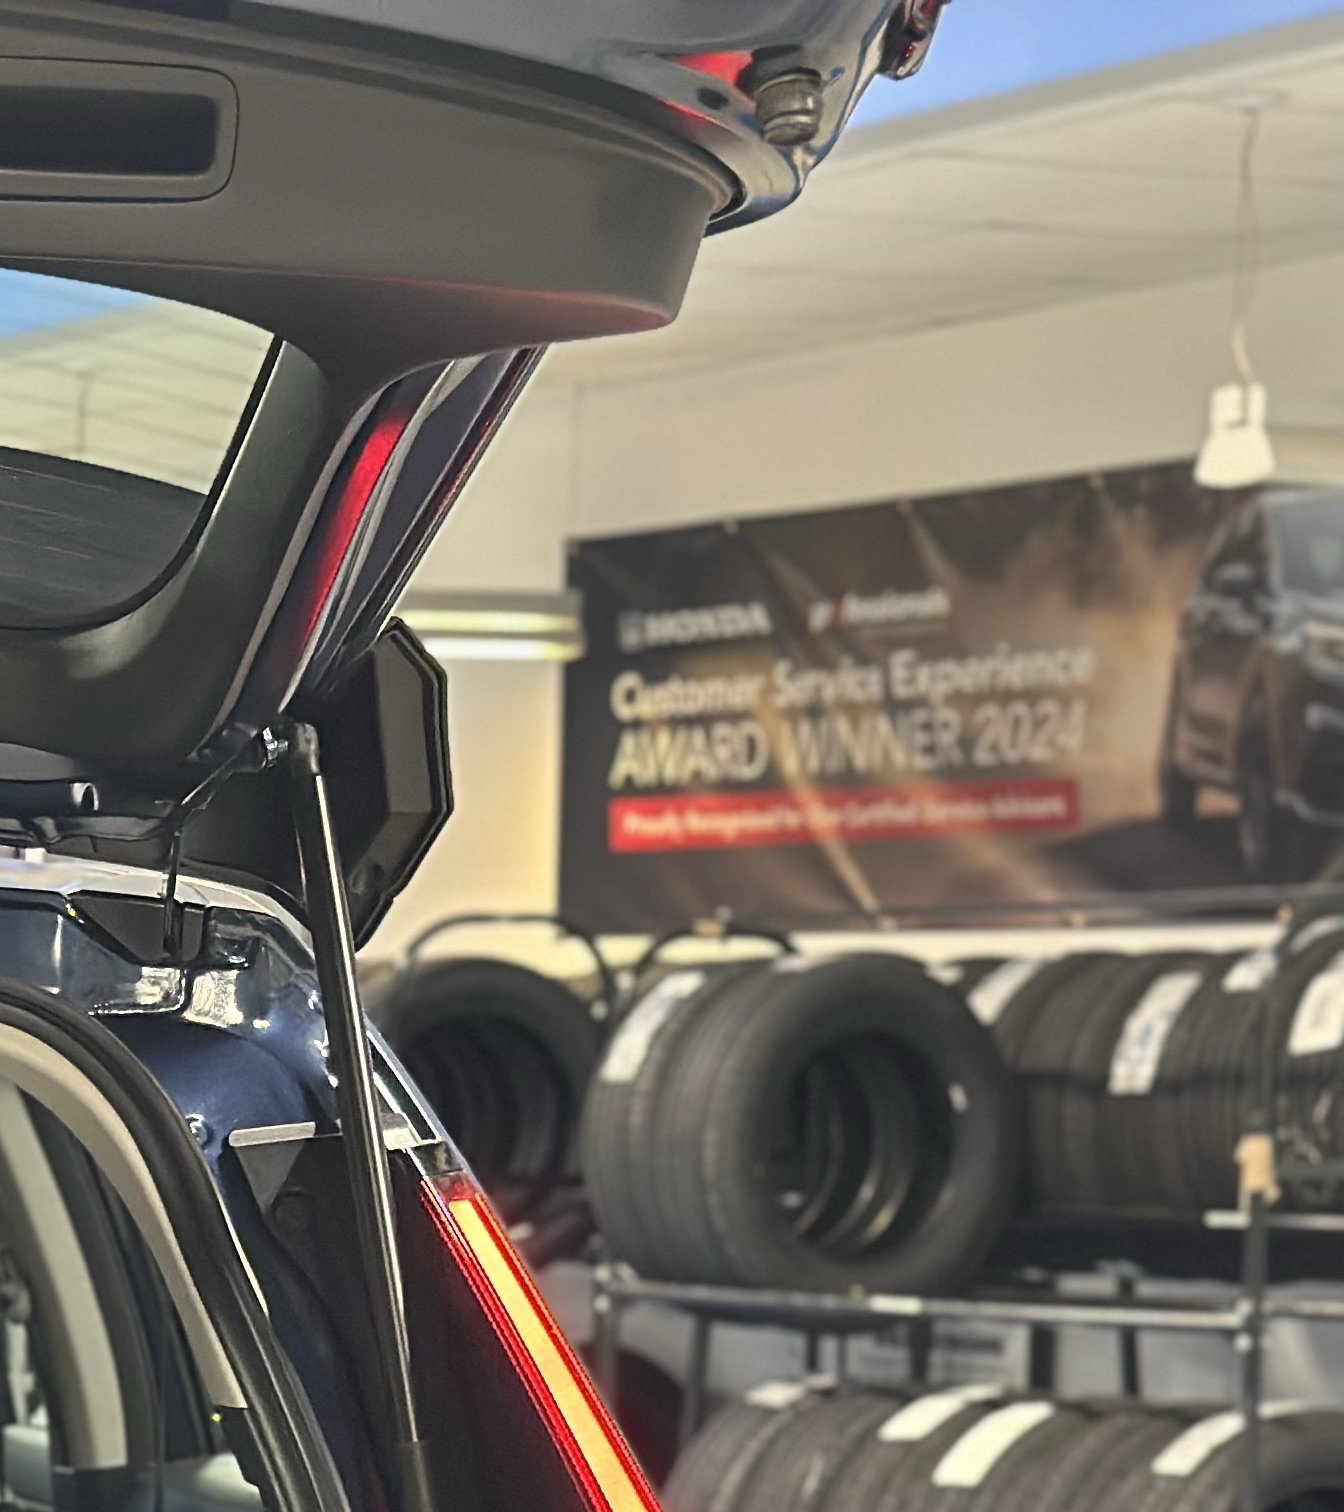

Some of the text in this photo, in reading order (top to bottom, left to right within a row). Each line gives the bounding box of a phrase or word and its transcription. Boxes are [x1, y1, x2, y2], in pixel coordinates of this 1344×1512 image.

[645, 602, 772, 646] HONDA
[610, 643, 1095, 722] Customer Service Experience
[608, 697, 1087, 788] AWARD WINNER 2024
